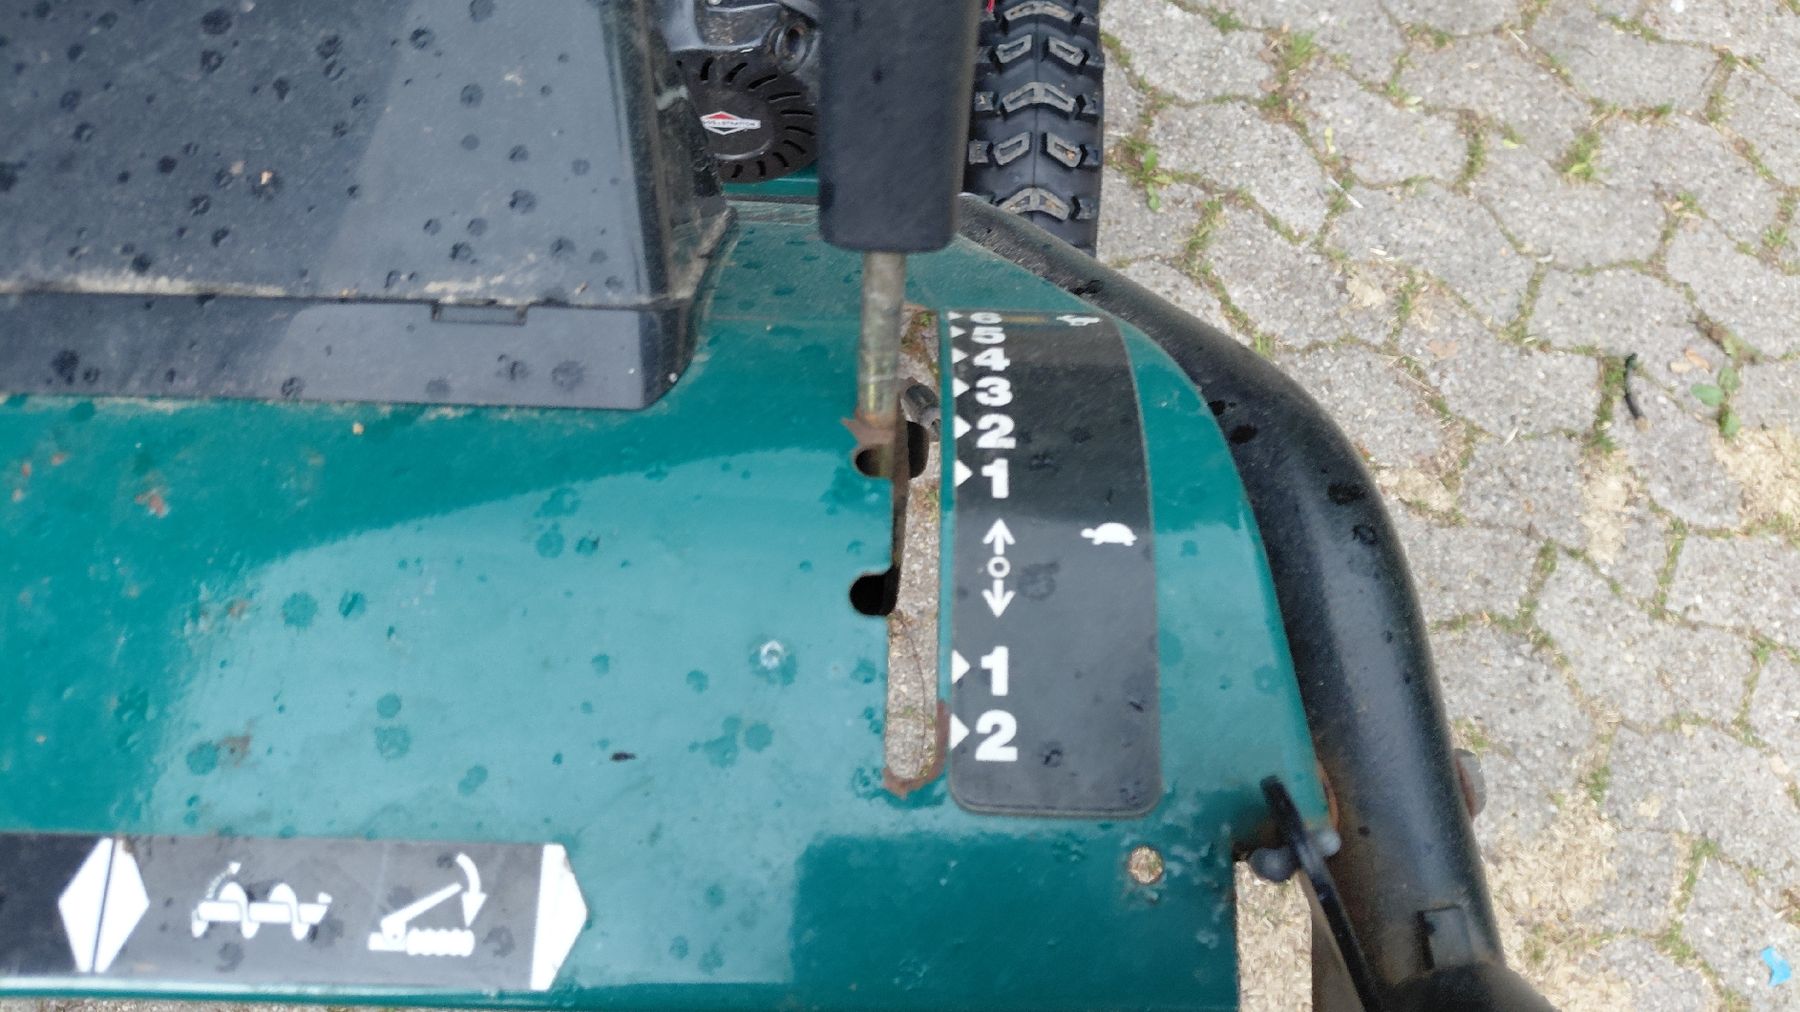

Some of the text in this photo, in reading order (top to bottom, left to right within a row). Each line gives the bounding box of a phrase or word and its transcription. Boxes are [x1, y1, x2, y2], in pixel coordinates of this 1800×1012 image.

[971, 326, 1006, 344] 5
[973, 347, 1010, 371] 4
[975, 376, 1013, 406] 3
[976, 413, 1016, 449] 2
[981, 458, 1009, 498] 1
[980, 645, 1009, 697] 1
[975, 709, 1018, 762] 2
